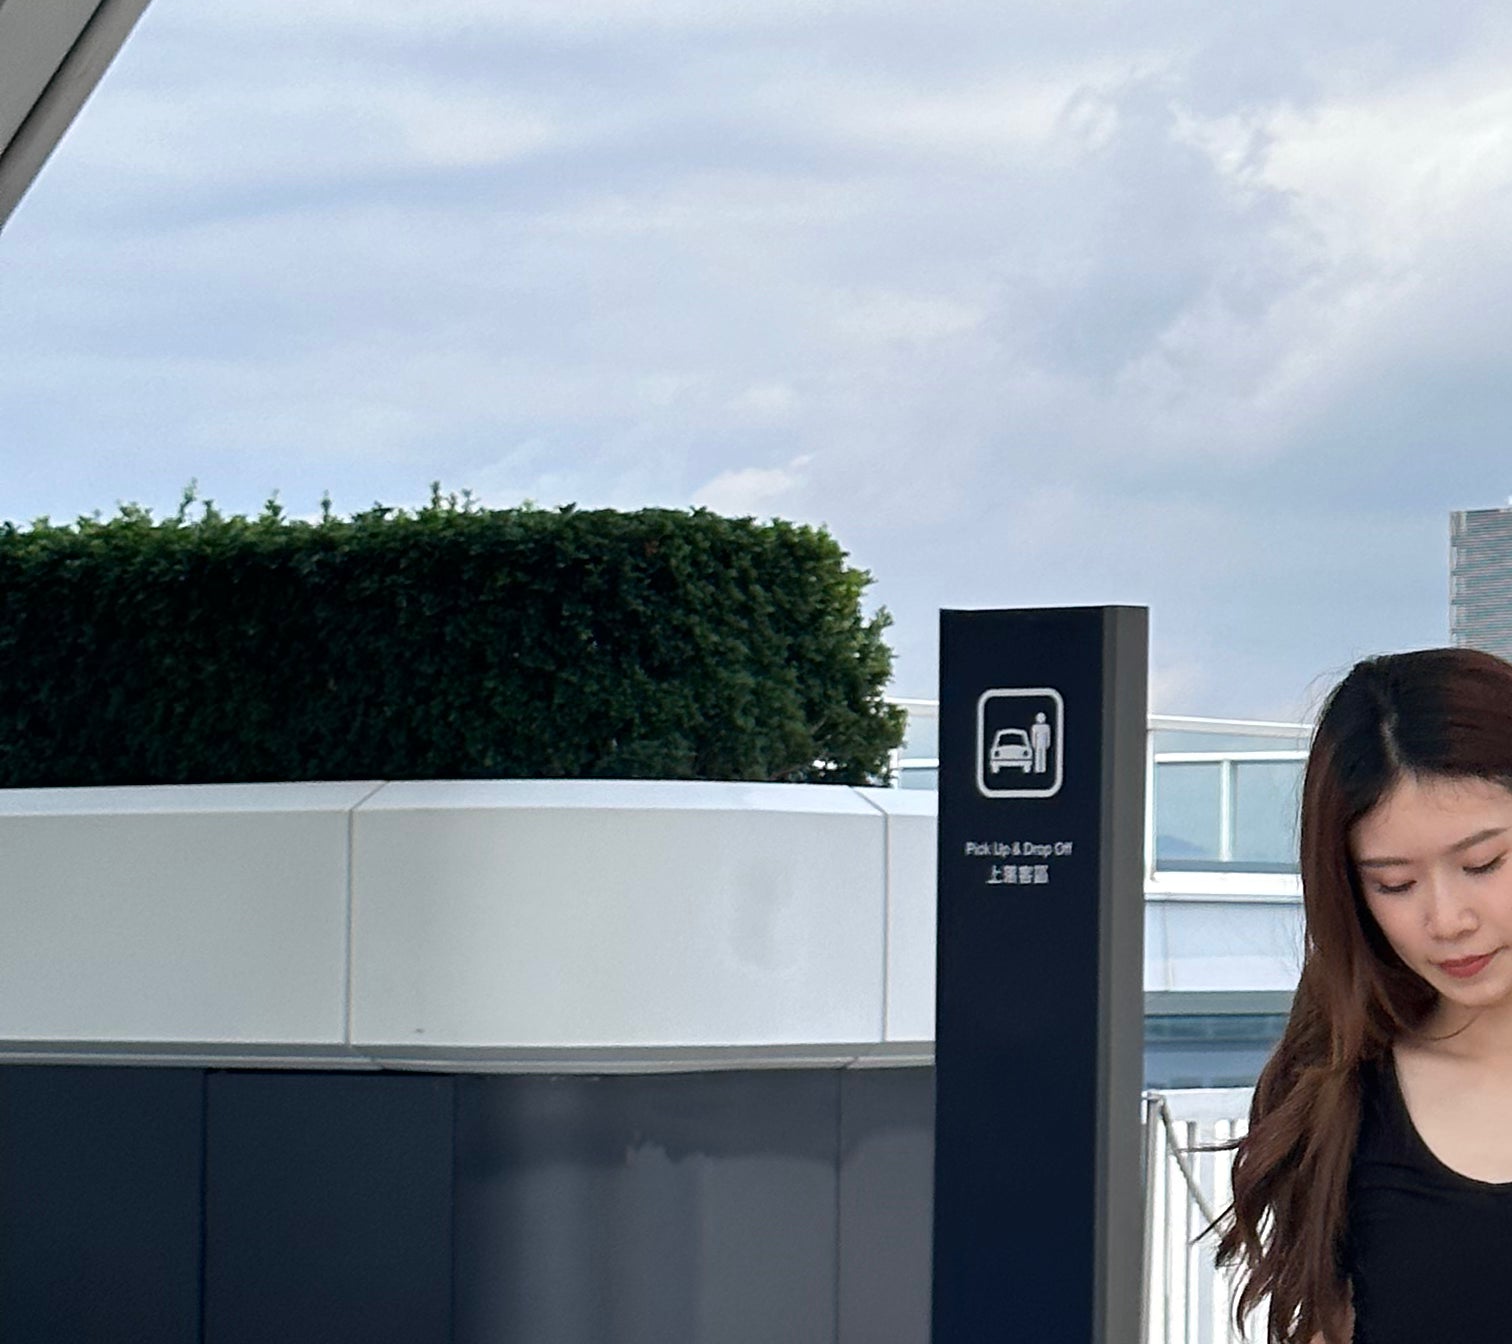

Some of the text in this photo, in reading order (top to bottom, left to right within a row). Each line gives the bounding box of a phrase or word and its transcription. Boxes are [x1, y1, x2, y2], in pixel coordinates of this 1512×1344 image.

[965, 841, 1073, 859] Pick Up & Drop Off
